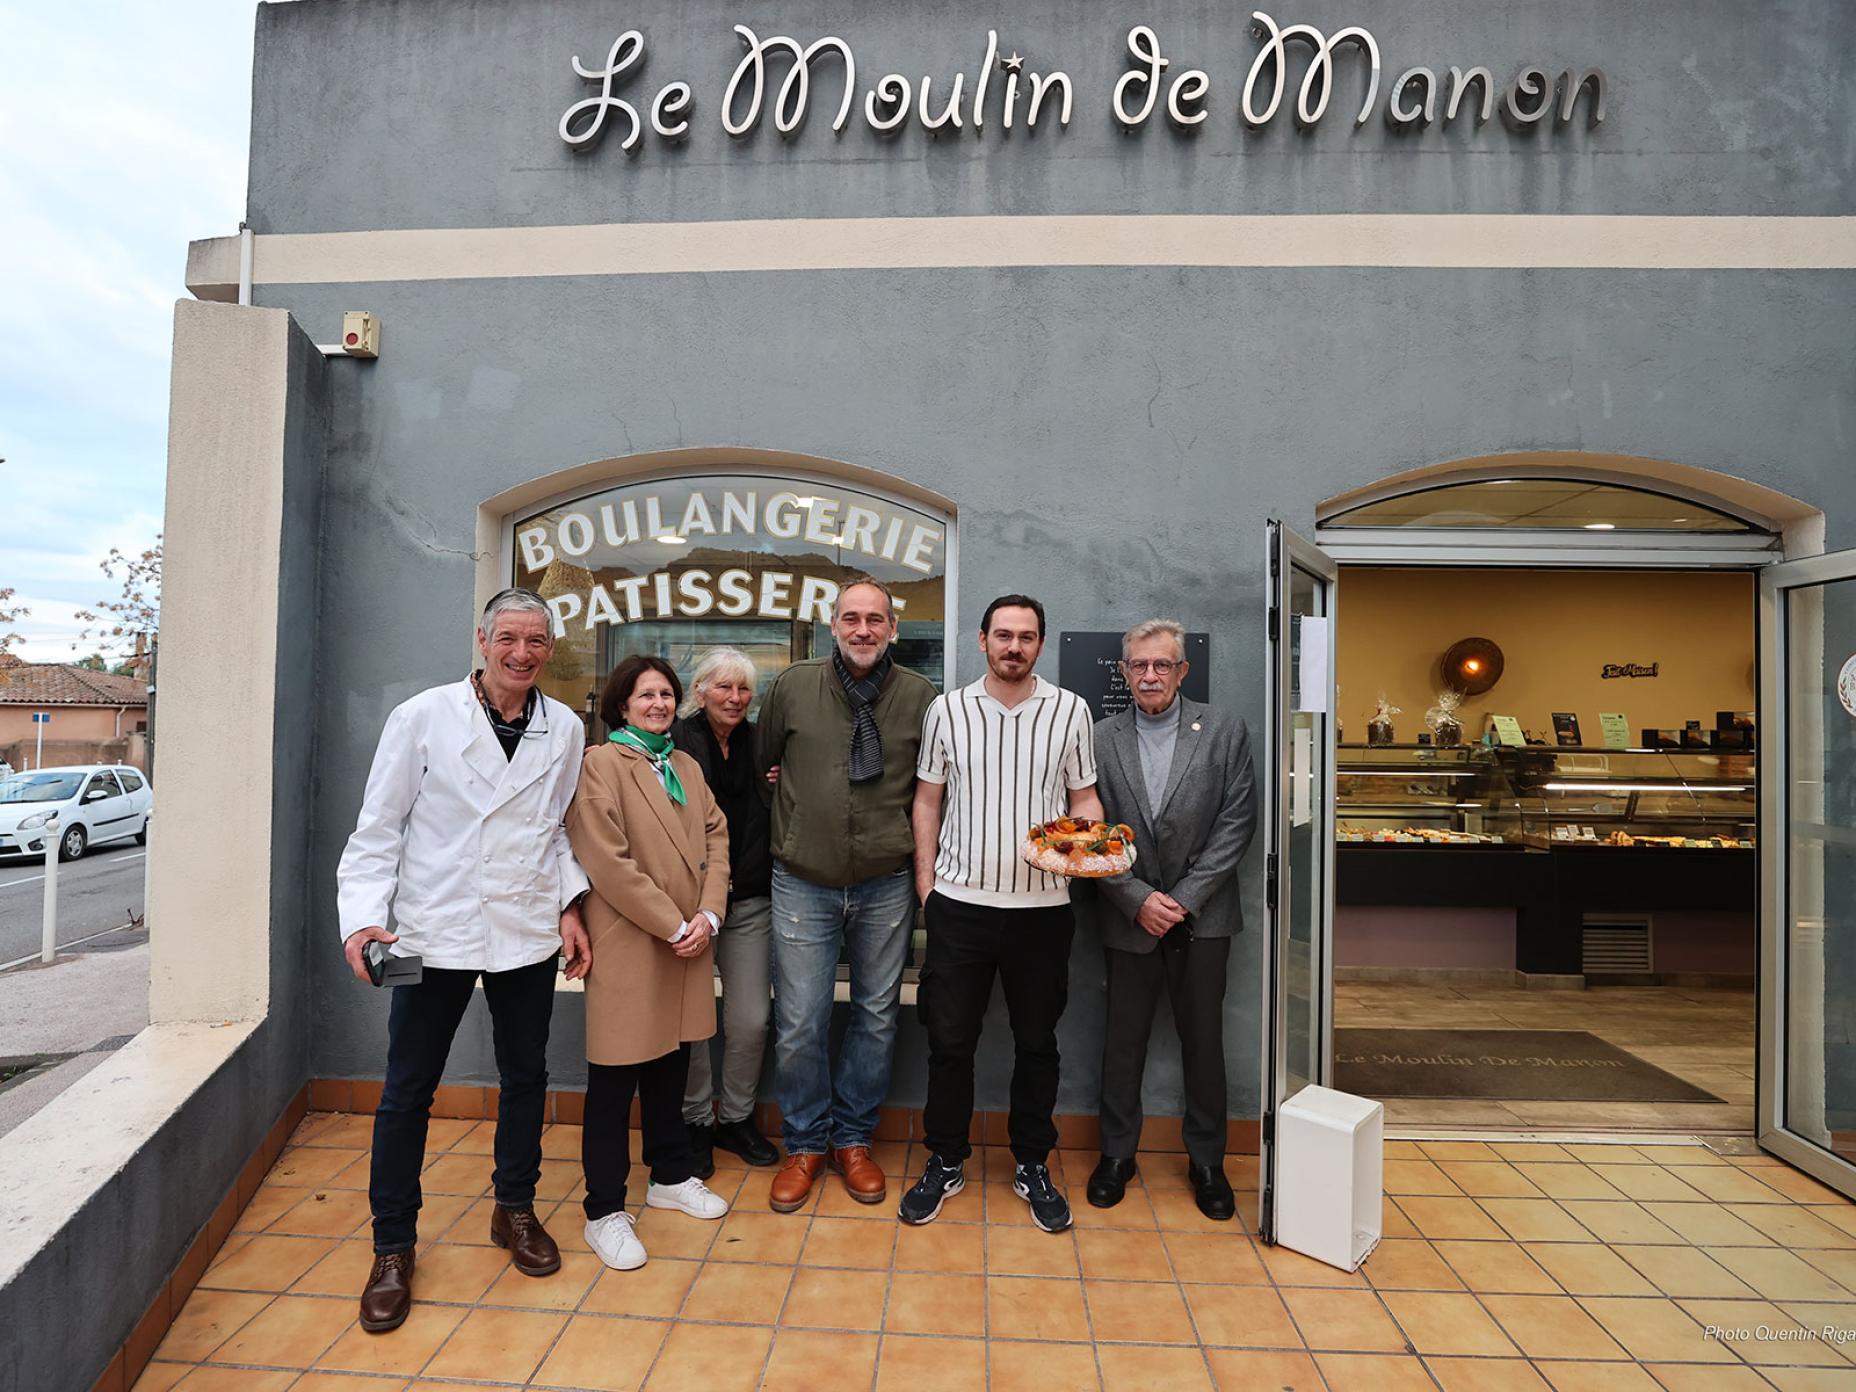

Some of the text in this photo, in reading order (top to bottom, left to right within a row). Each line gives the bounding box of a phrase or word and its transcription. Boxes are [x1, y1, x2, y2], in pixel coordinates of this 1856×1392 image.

[558, 10, 1608, 152] Le Moulin de Manon
[517, 490, 946, 575] BOULANGERIE
[546, 568, 907, 642] PATISSER
[1373, 1053, 1476, 1066] Moulin
[1479, 1056, 1521, 1066] De
[1525, 1056, 1625, 1068] Manon
